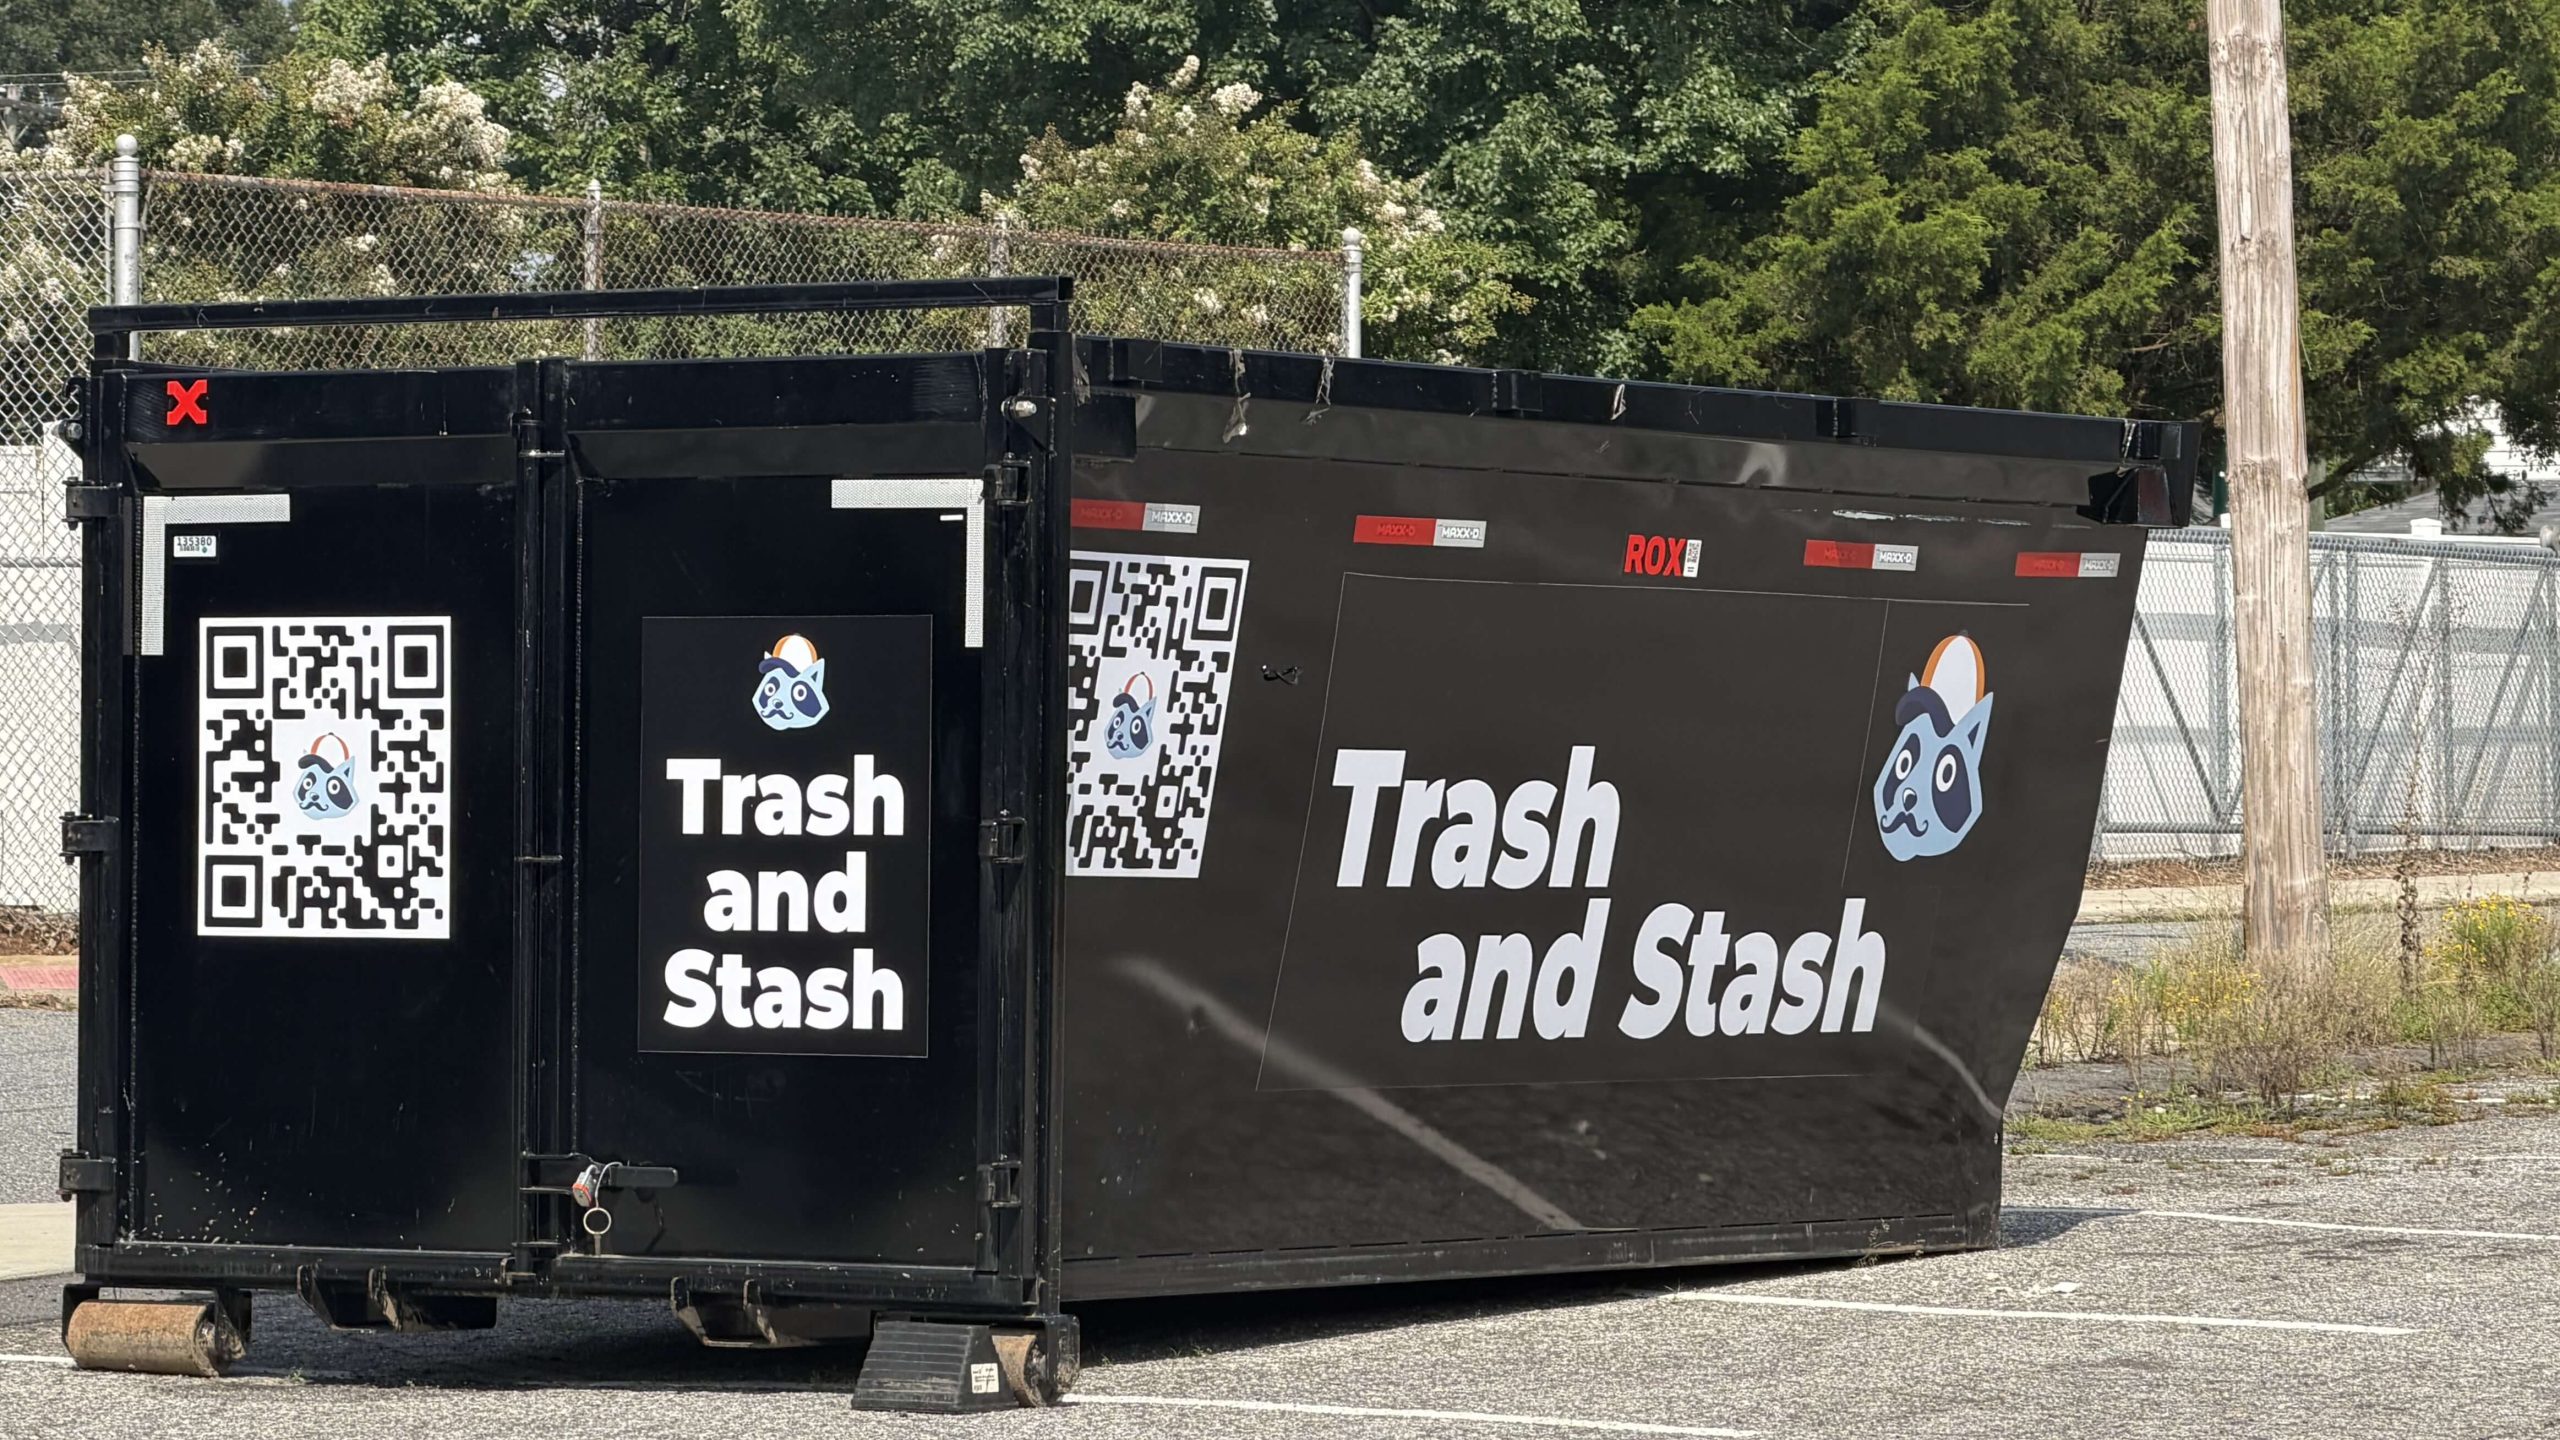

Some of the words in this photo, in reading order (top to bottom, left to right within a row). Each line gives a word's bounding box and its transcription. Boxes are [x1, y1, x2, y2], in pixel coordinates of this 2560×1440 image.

[177, 536, 213, 546] 135380
[1151, 510, 1193, 524] MAXX-D
[1441, 526, 1480, 539] MAXX-D
[1624, 534, 1687, 576] ROX
[1879, 550, 1913, 564] MAXX-D
[666, 754, 905, 836] Trash
[1332, 746, 1621, 890] Trash
[703, 851, 867, 933] and
[663, 948, 904, 1031] Stash
[1400, 898, 1612, 1043] and
[1618, 898, 1886, 1040] Stash
